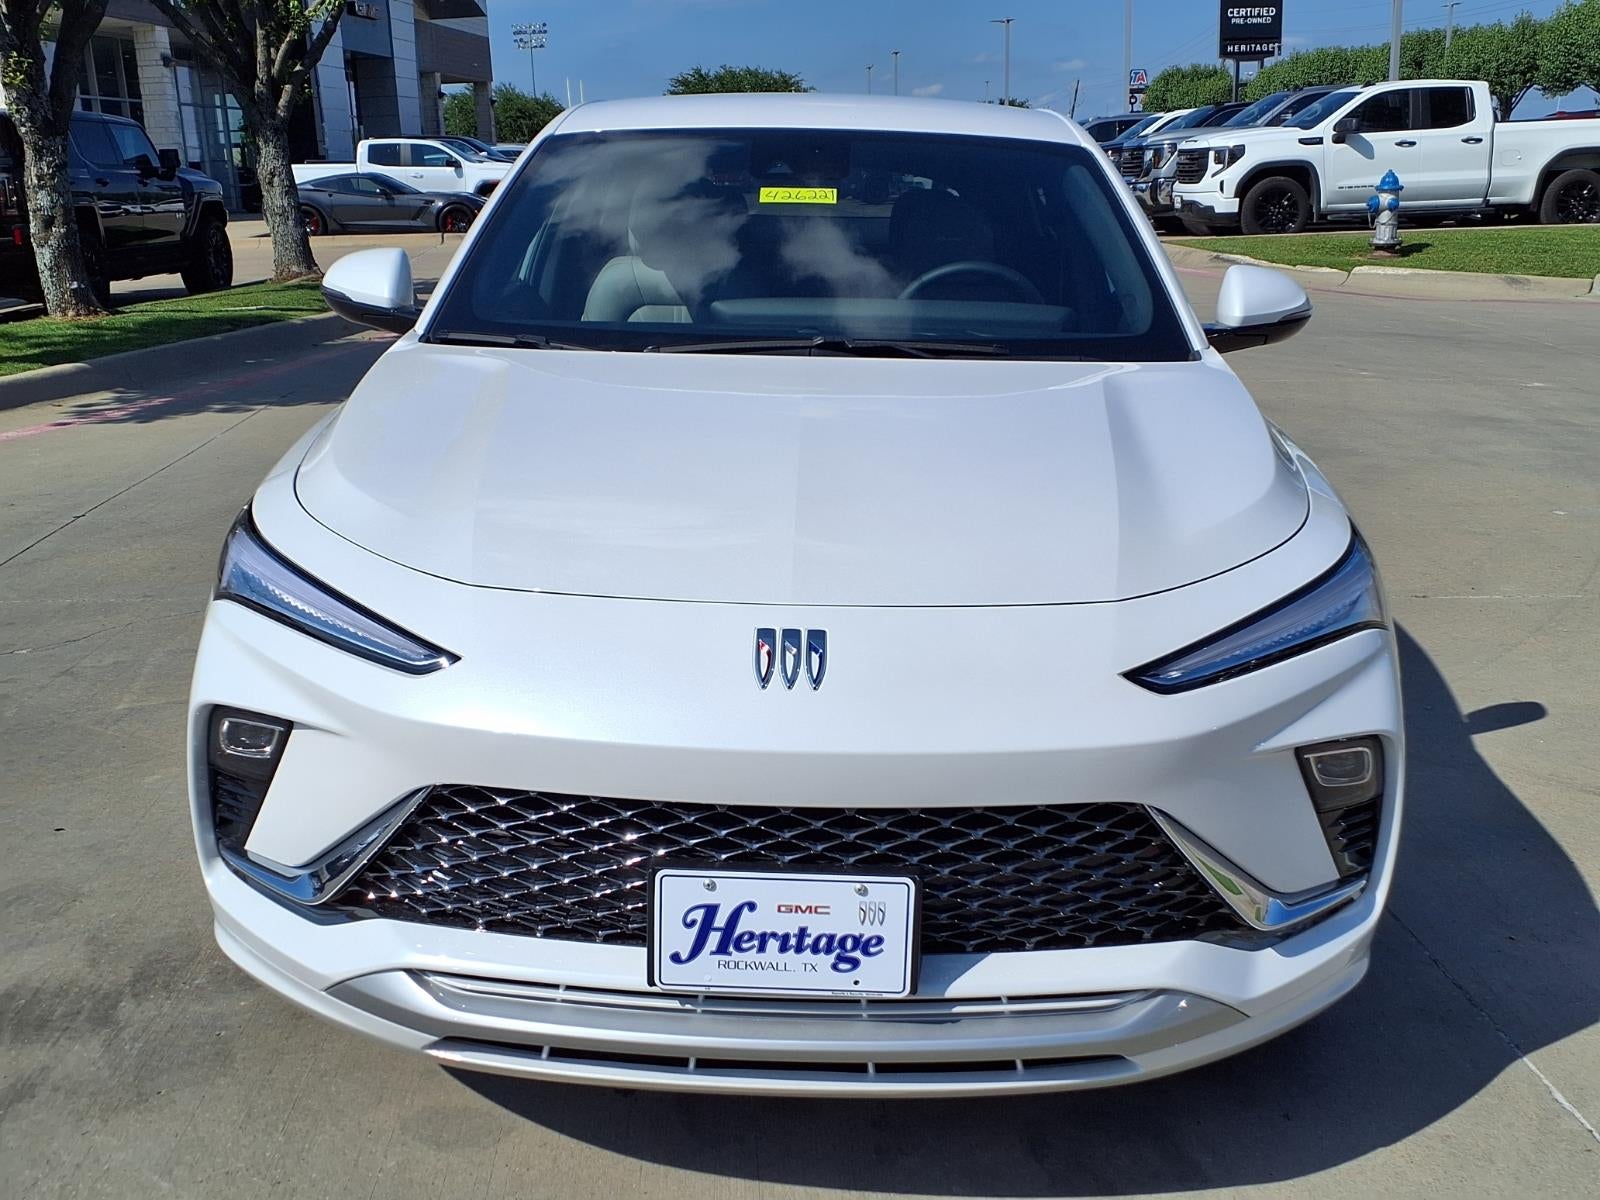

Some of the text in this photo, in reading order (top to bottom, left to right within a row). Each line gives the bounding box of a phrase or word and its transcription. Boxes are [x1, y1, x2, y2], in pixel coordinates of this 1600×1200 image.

[1227, 7, 1276, 17] CERTIFIED
[1231, 16, 1272, 25] PRE-OWNED
[1227, 43, 1275, 53] HERITAGE
[1130, 70, 1147, 85] TA
[765, 189, 835, 202] 426221
[777, 904, 831, 915] GMC
[669, 900, 886, 974] Heritage
[801, 962, 818, 973] TX
